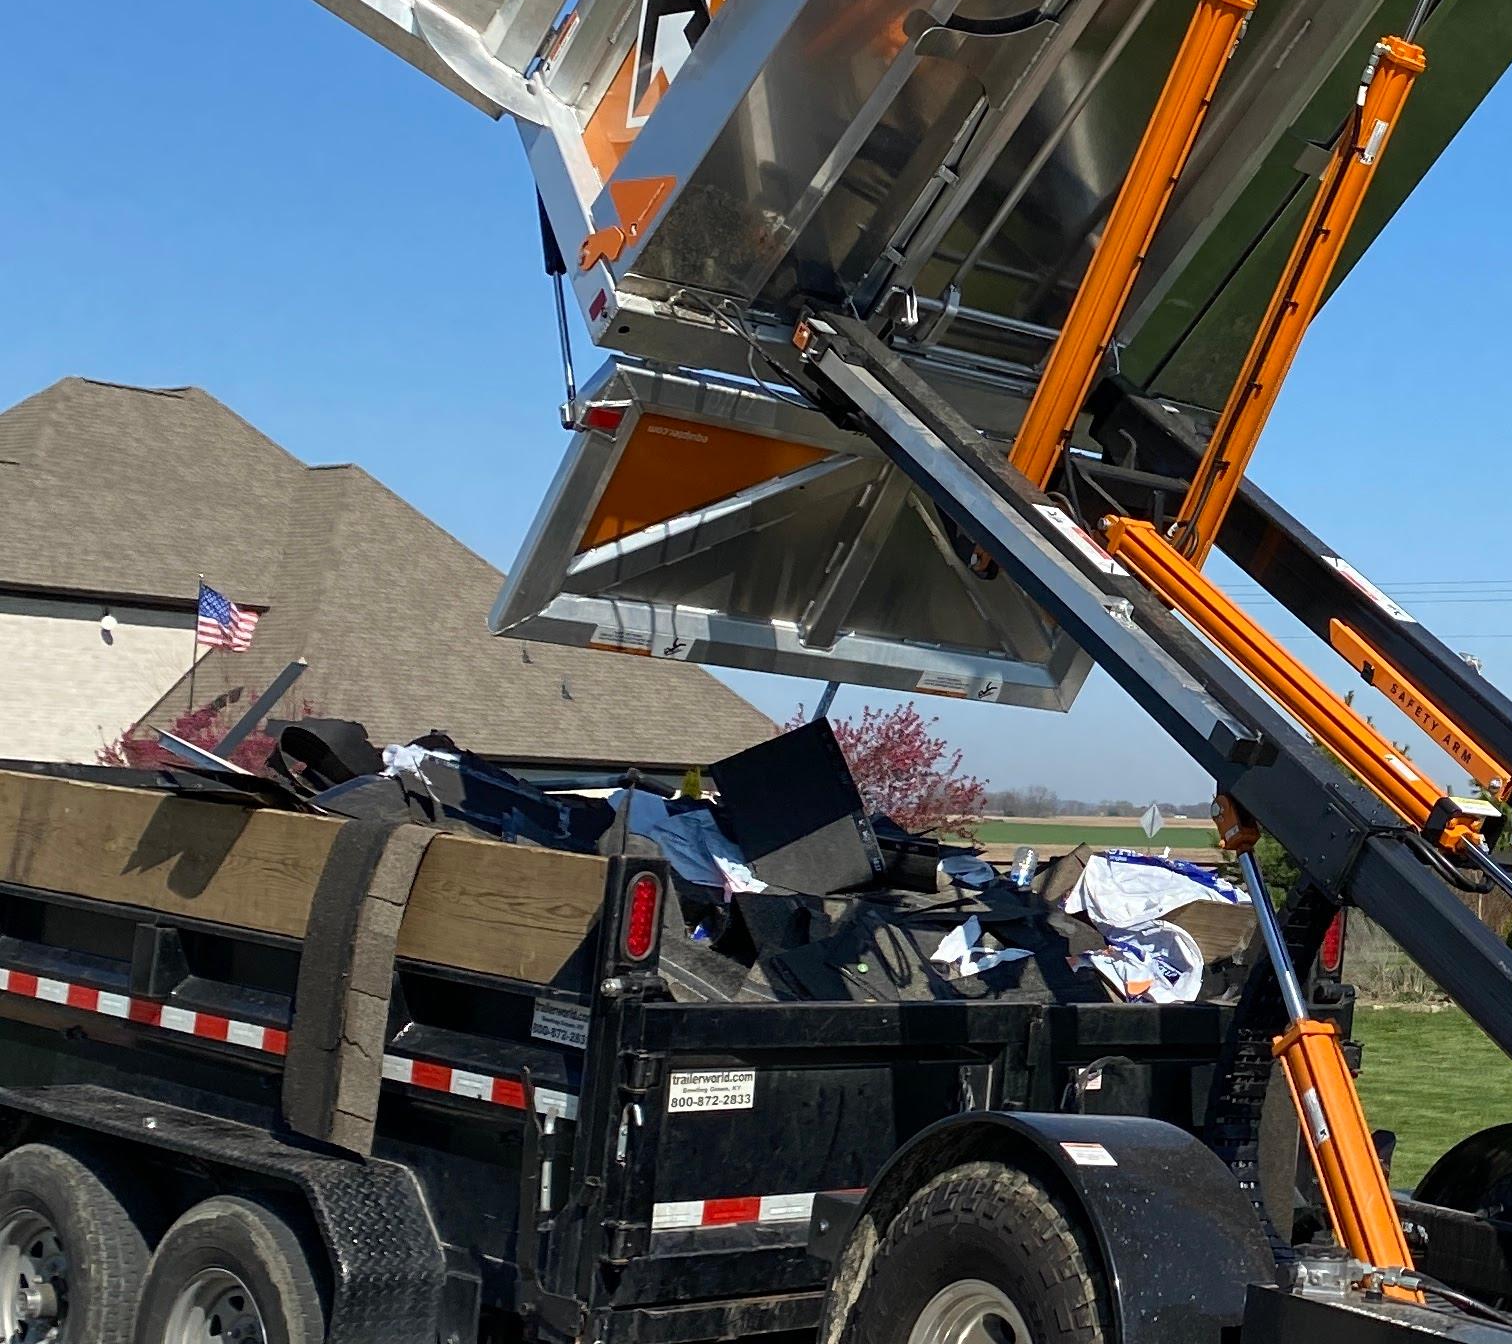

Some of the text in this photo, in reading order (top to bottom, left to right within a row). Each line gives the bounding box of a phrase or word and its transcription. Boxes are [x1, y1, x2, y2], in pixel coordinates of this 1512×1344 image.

[1390, 683, 1472, 764] SAFETY ARM
[672, 1072, 754, 1086] trailerworld.com
[670, 1094, 751, 1108] 800-872-2833
